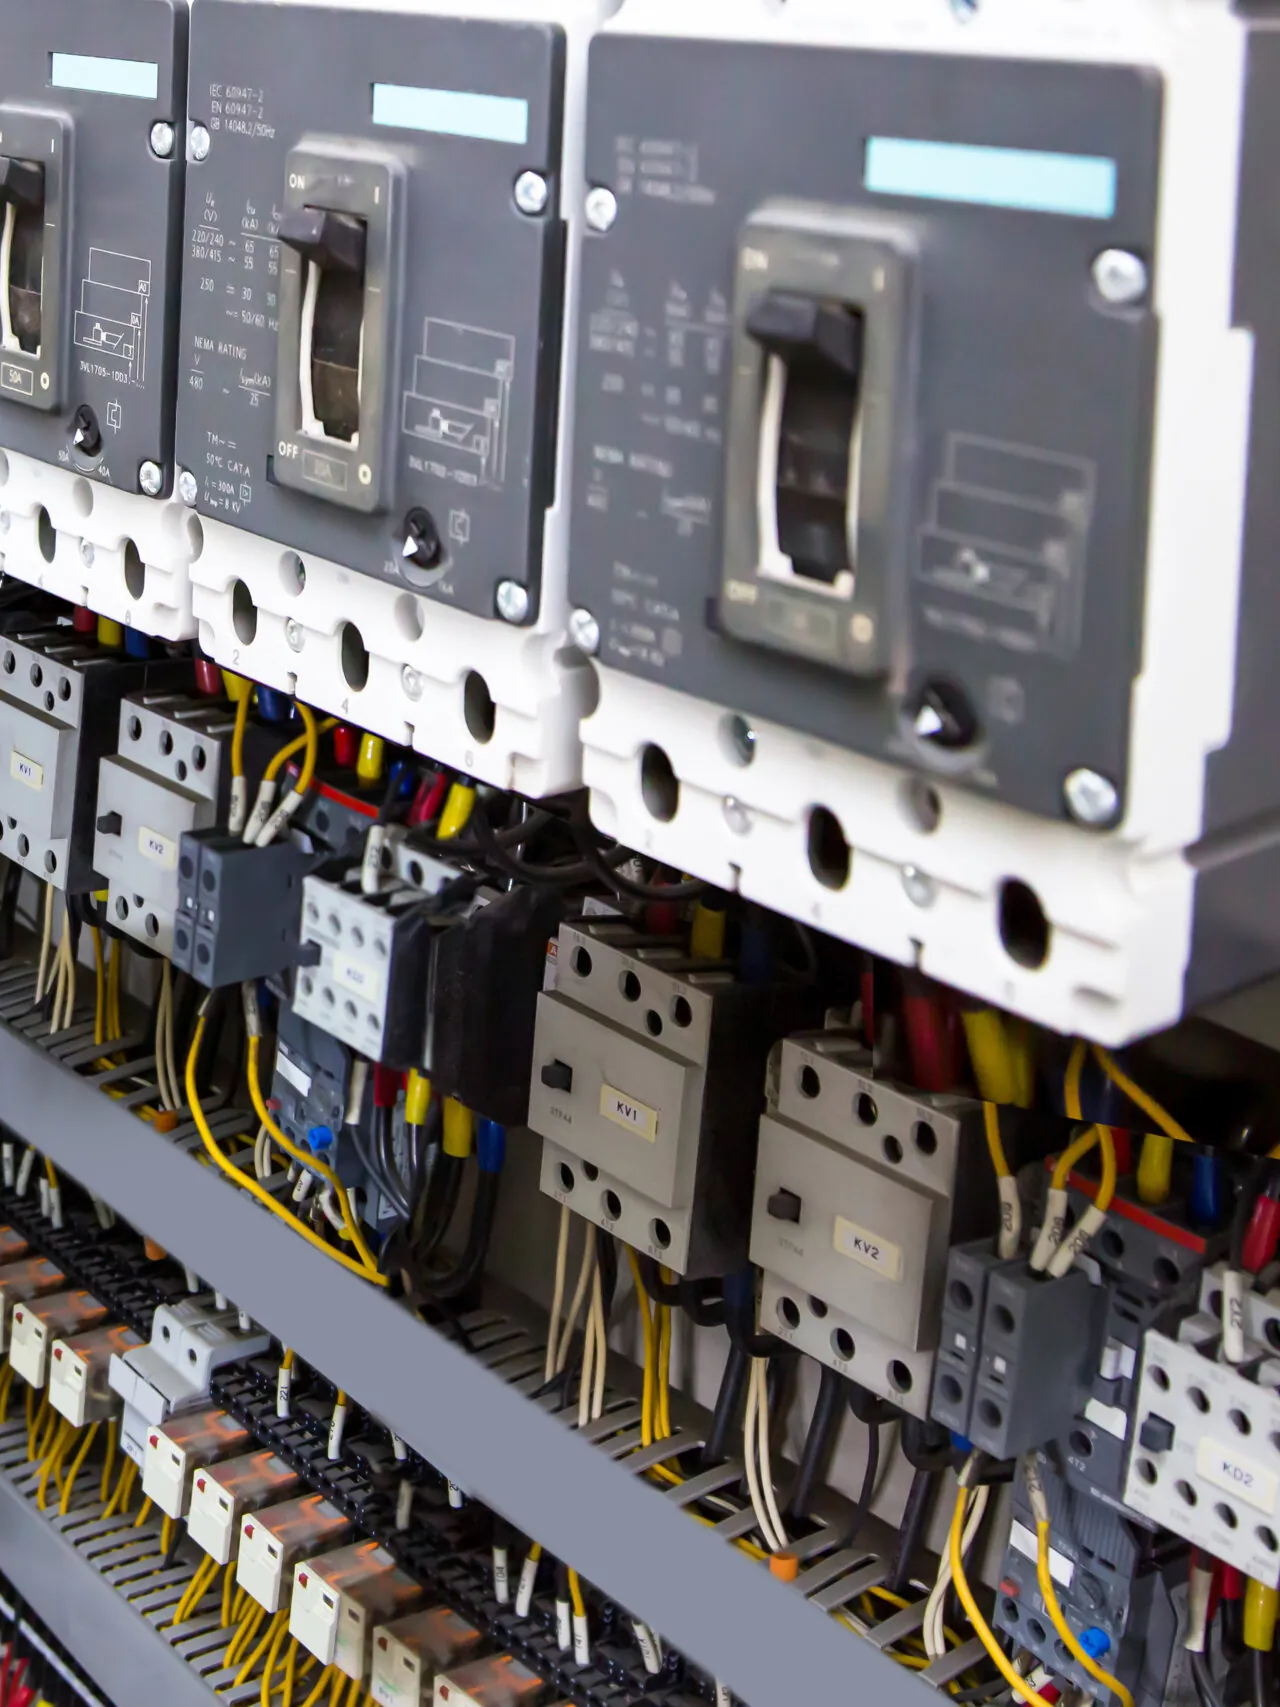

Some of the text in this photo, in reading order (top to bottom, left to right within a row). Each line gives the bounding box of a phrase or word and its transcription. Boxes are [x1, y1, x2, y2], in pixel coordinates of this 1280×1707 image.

[209, 84, 222, 97] IEC
[211, 101, 264, 119] EN 60947-2
[289, 173, 305, 189] ON
[192, 229, 224, 247] 220/240
[192, 244, 222, 263] 380/415
[200, 277, 215, 292] 250
[194, 335, 247, 360] NEMA RATING
[278, 441, 299, 460] OFF
[19, 762, 33, 777] KV1
[148, 838, 164, 855] KV2
[616, 1100, 638, 1122] KV1
[853, 1236, 880, 1261] KV2
[279, 1386, 288, 1401] 221
[1222, 1461, 1254, 1488] KD2
